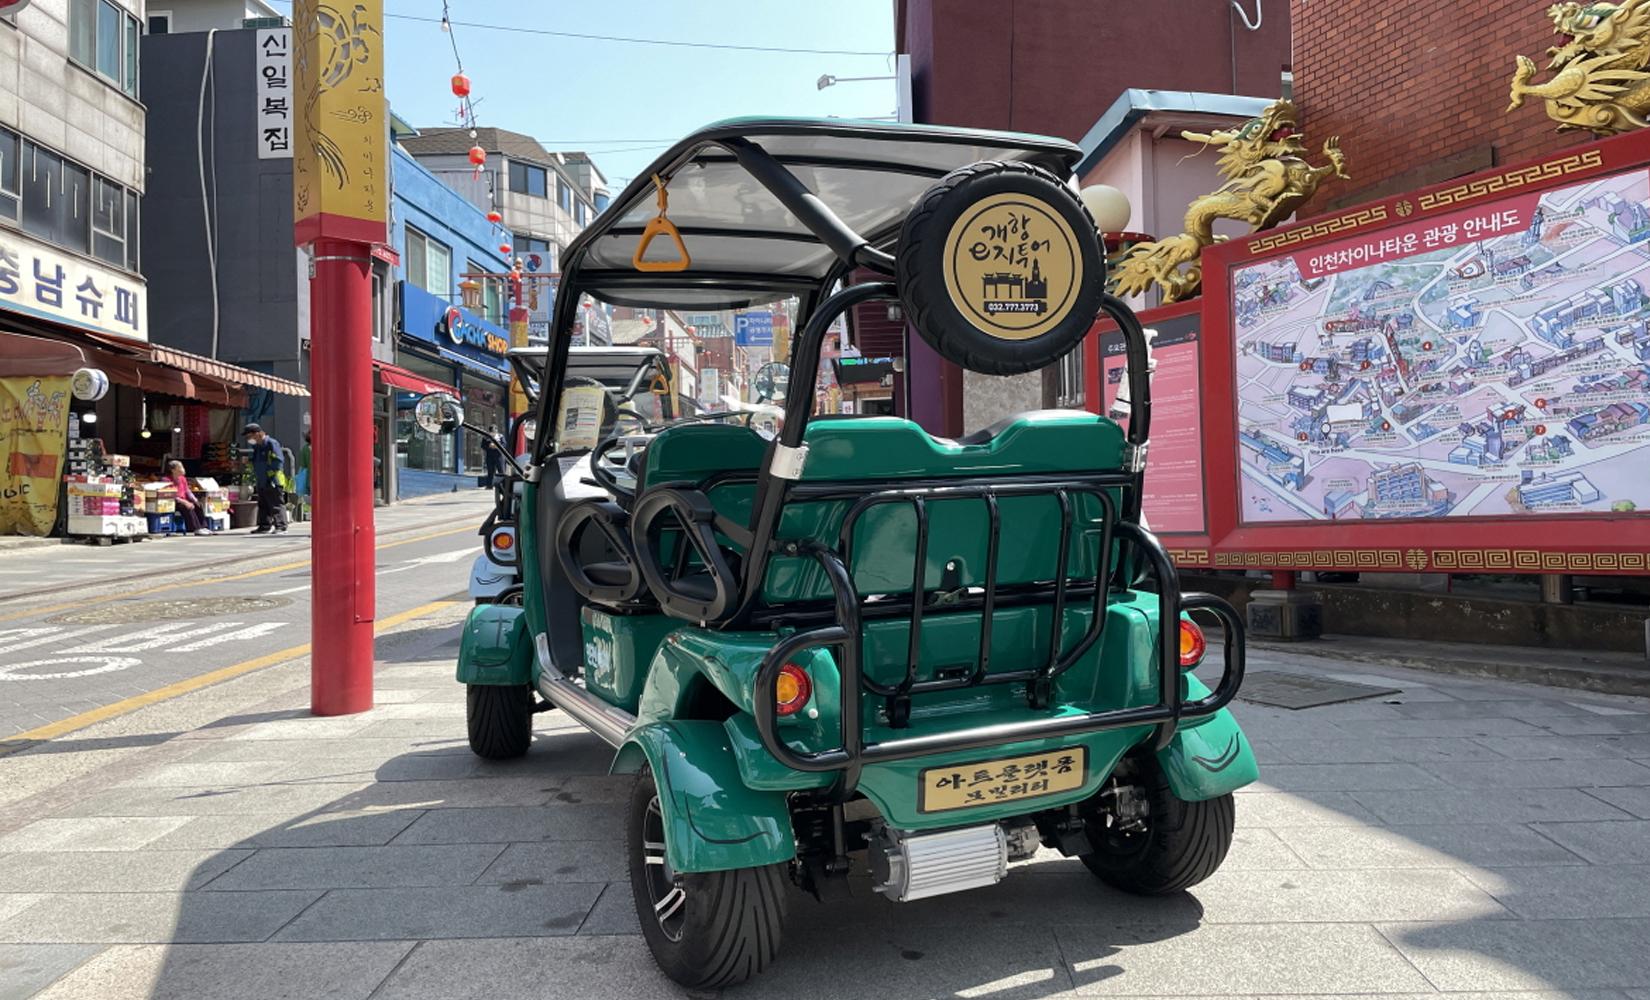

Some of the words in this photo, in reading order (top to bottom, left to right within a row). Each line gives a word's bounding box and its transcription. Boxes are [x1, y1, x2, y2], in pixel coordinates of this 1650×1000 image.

[262, 33, 289, 151] 신일복집
[981, 212, 1031, 241] 개항
[1309, 233, 1419, 274] 인천차이나타운
[1422, 223, 1459, 247] 관광
[1463, 209, 1521, 238] 안내도
[737, 317, 749, 333] P
[935, 755, 1076, 790] 아트플랫폼
